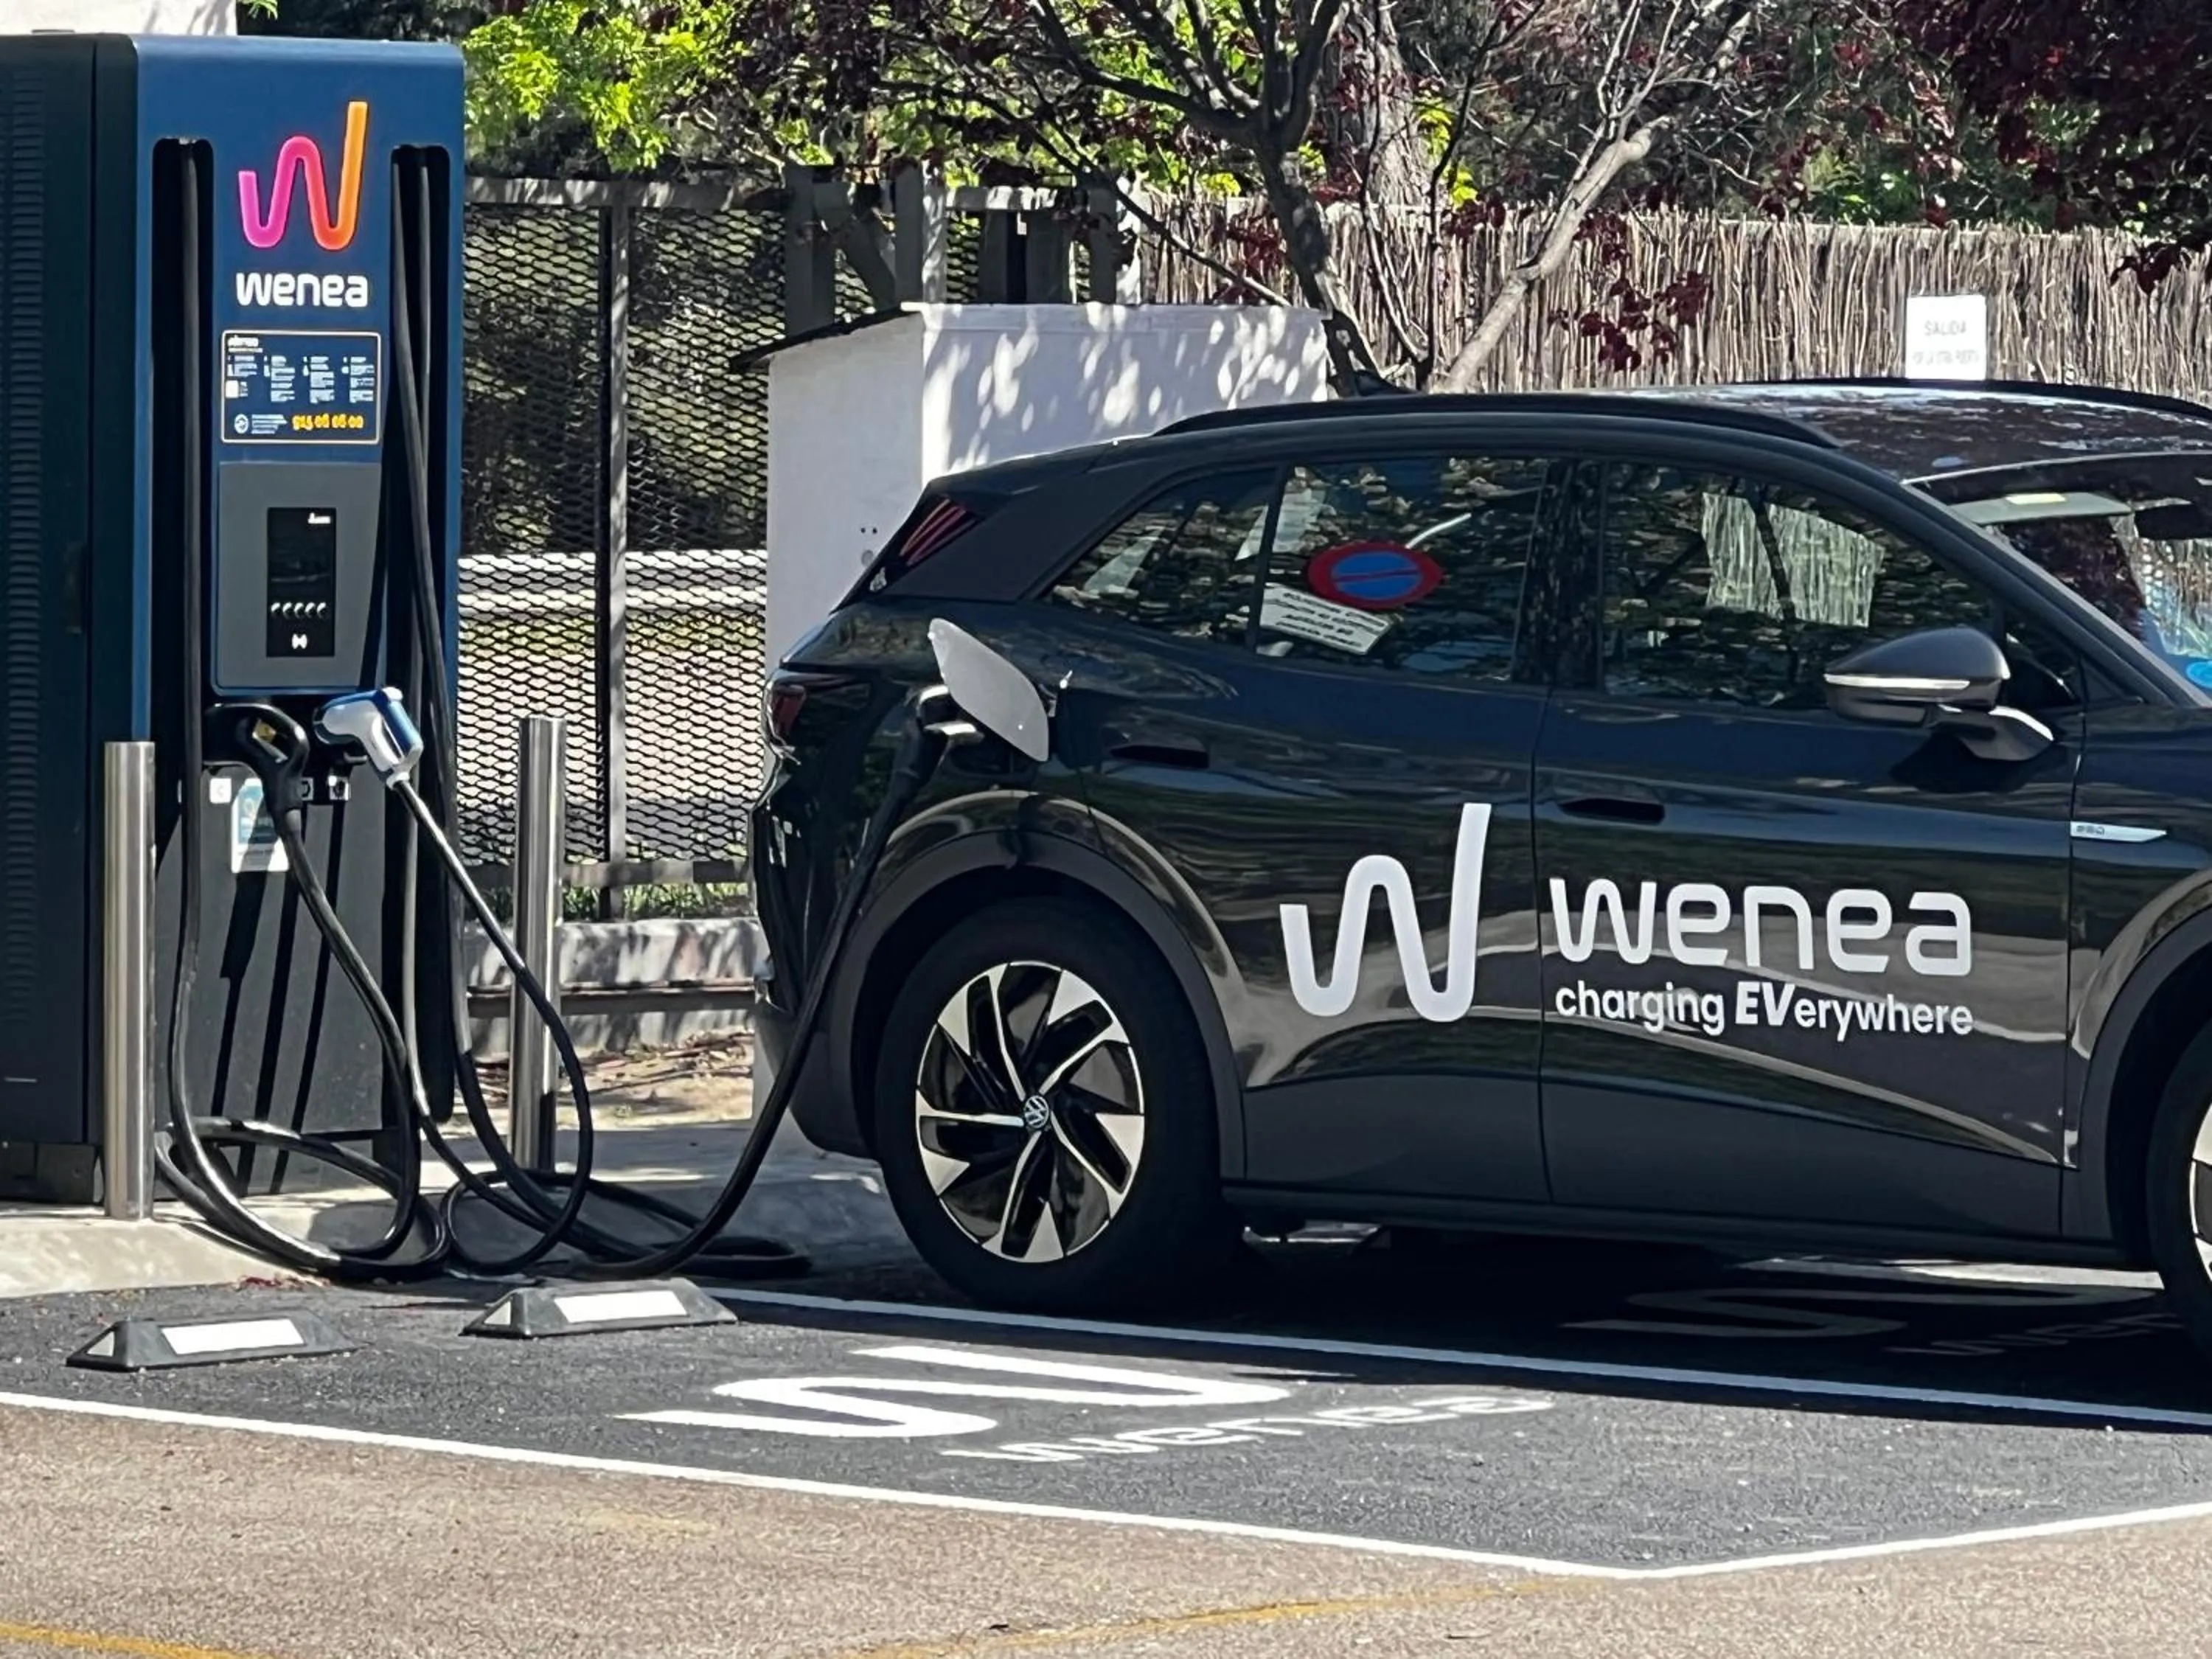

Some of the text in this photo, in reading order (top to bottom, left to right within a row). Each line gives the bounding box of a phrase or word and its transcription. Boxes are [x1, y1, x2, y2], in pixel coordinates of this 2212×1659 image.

[235, 272, 369, 308] wenea
[1549, 877, 1972, 976] wenea
[1555, 980, 1975, 1042] charging EVerywhere
[941, 1395, 1554, 1462] wenea
